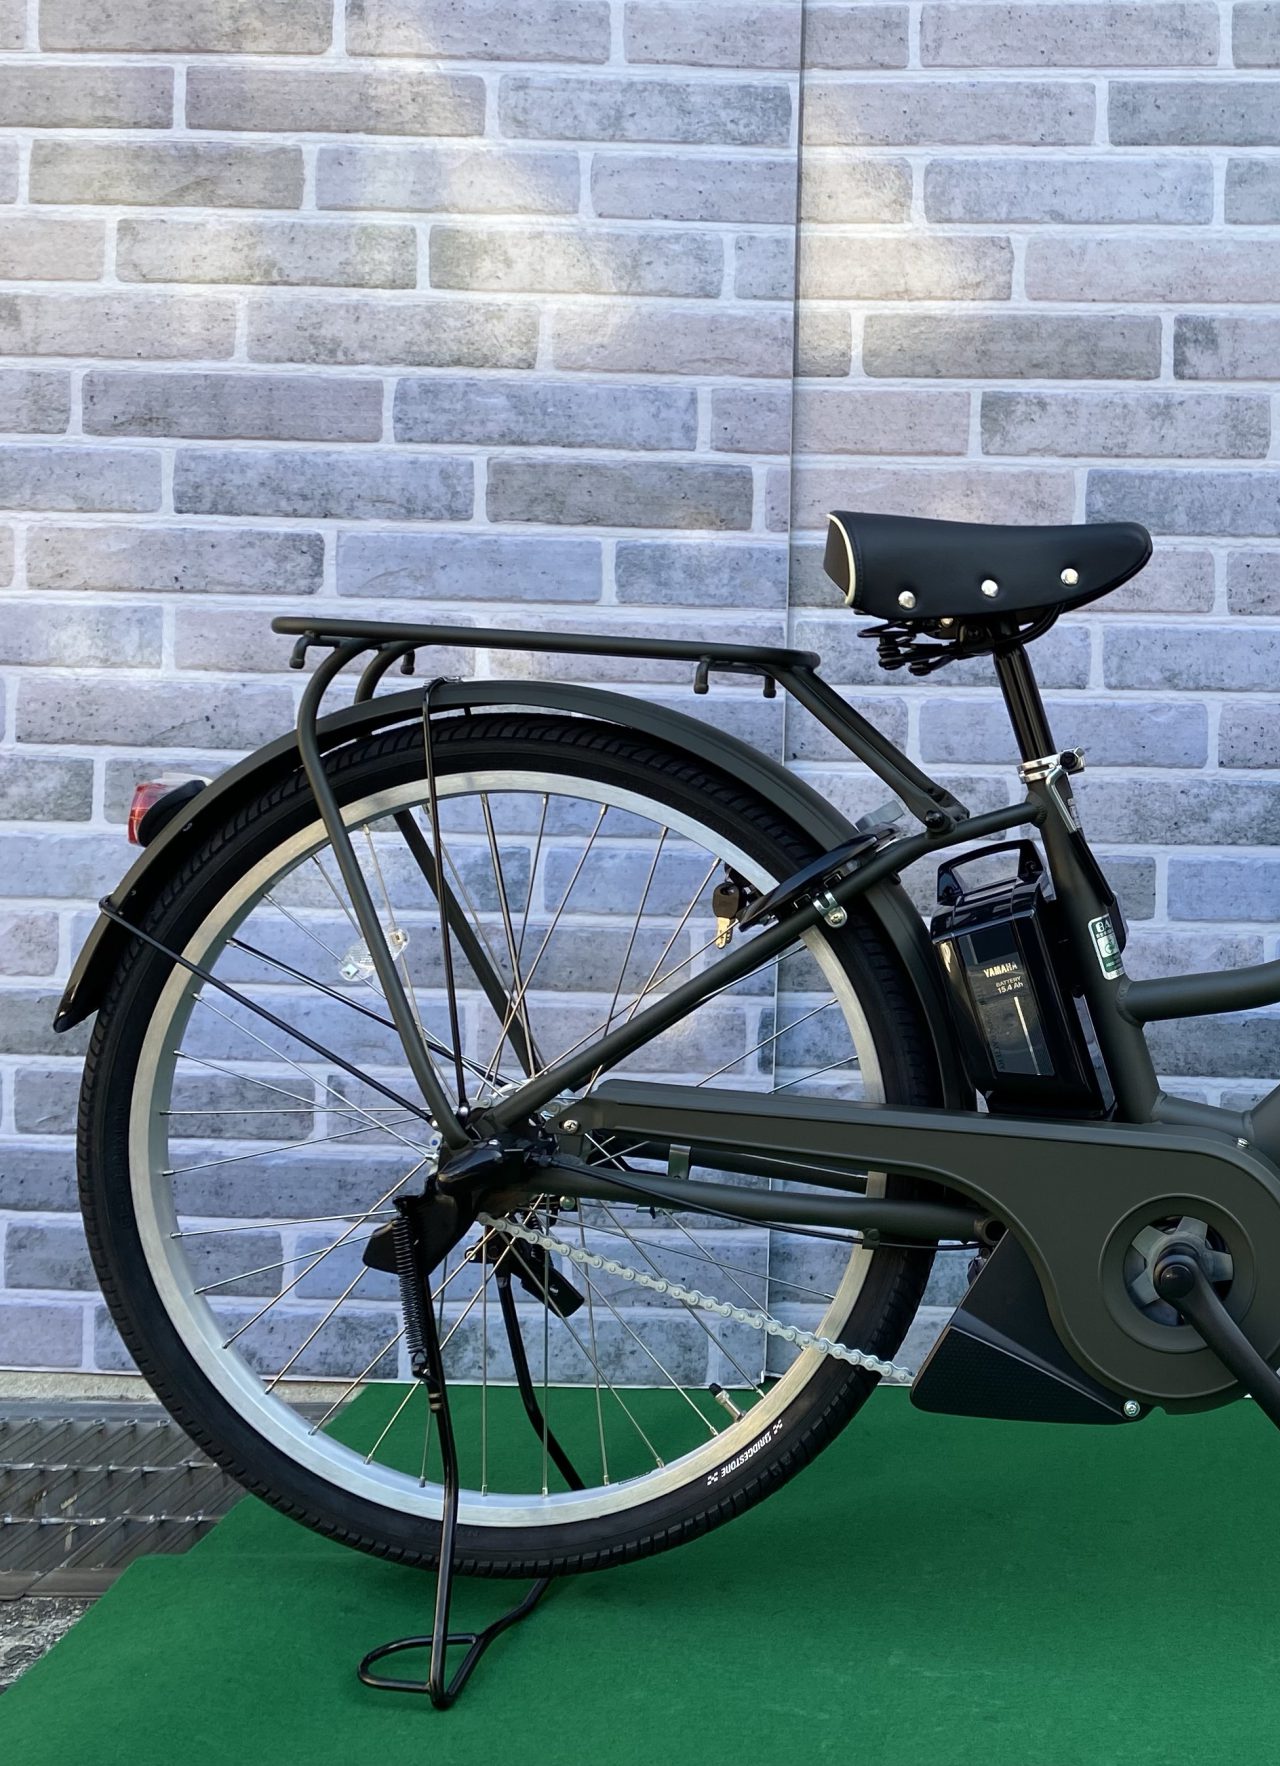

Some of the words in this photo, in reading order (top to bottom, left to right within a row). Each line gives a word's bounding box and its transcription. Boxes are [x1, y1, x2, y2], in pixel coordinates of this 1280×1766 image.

[983, 961, 1018, 978] YAMAHA
[995, 976, 1021, 987] BATTERY
[997, 984, 1013, 994] 15.4
[1013, 981, 1024, 989] Ah
[721, 1431, 772, 1477] BRIDGESTONE
